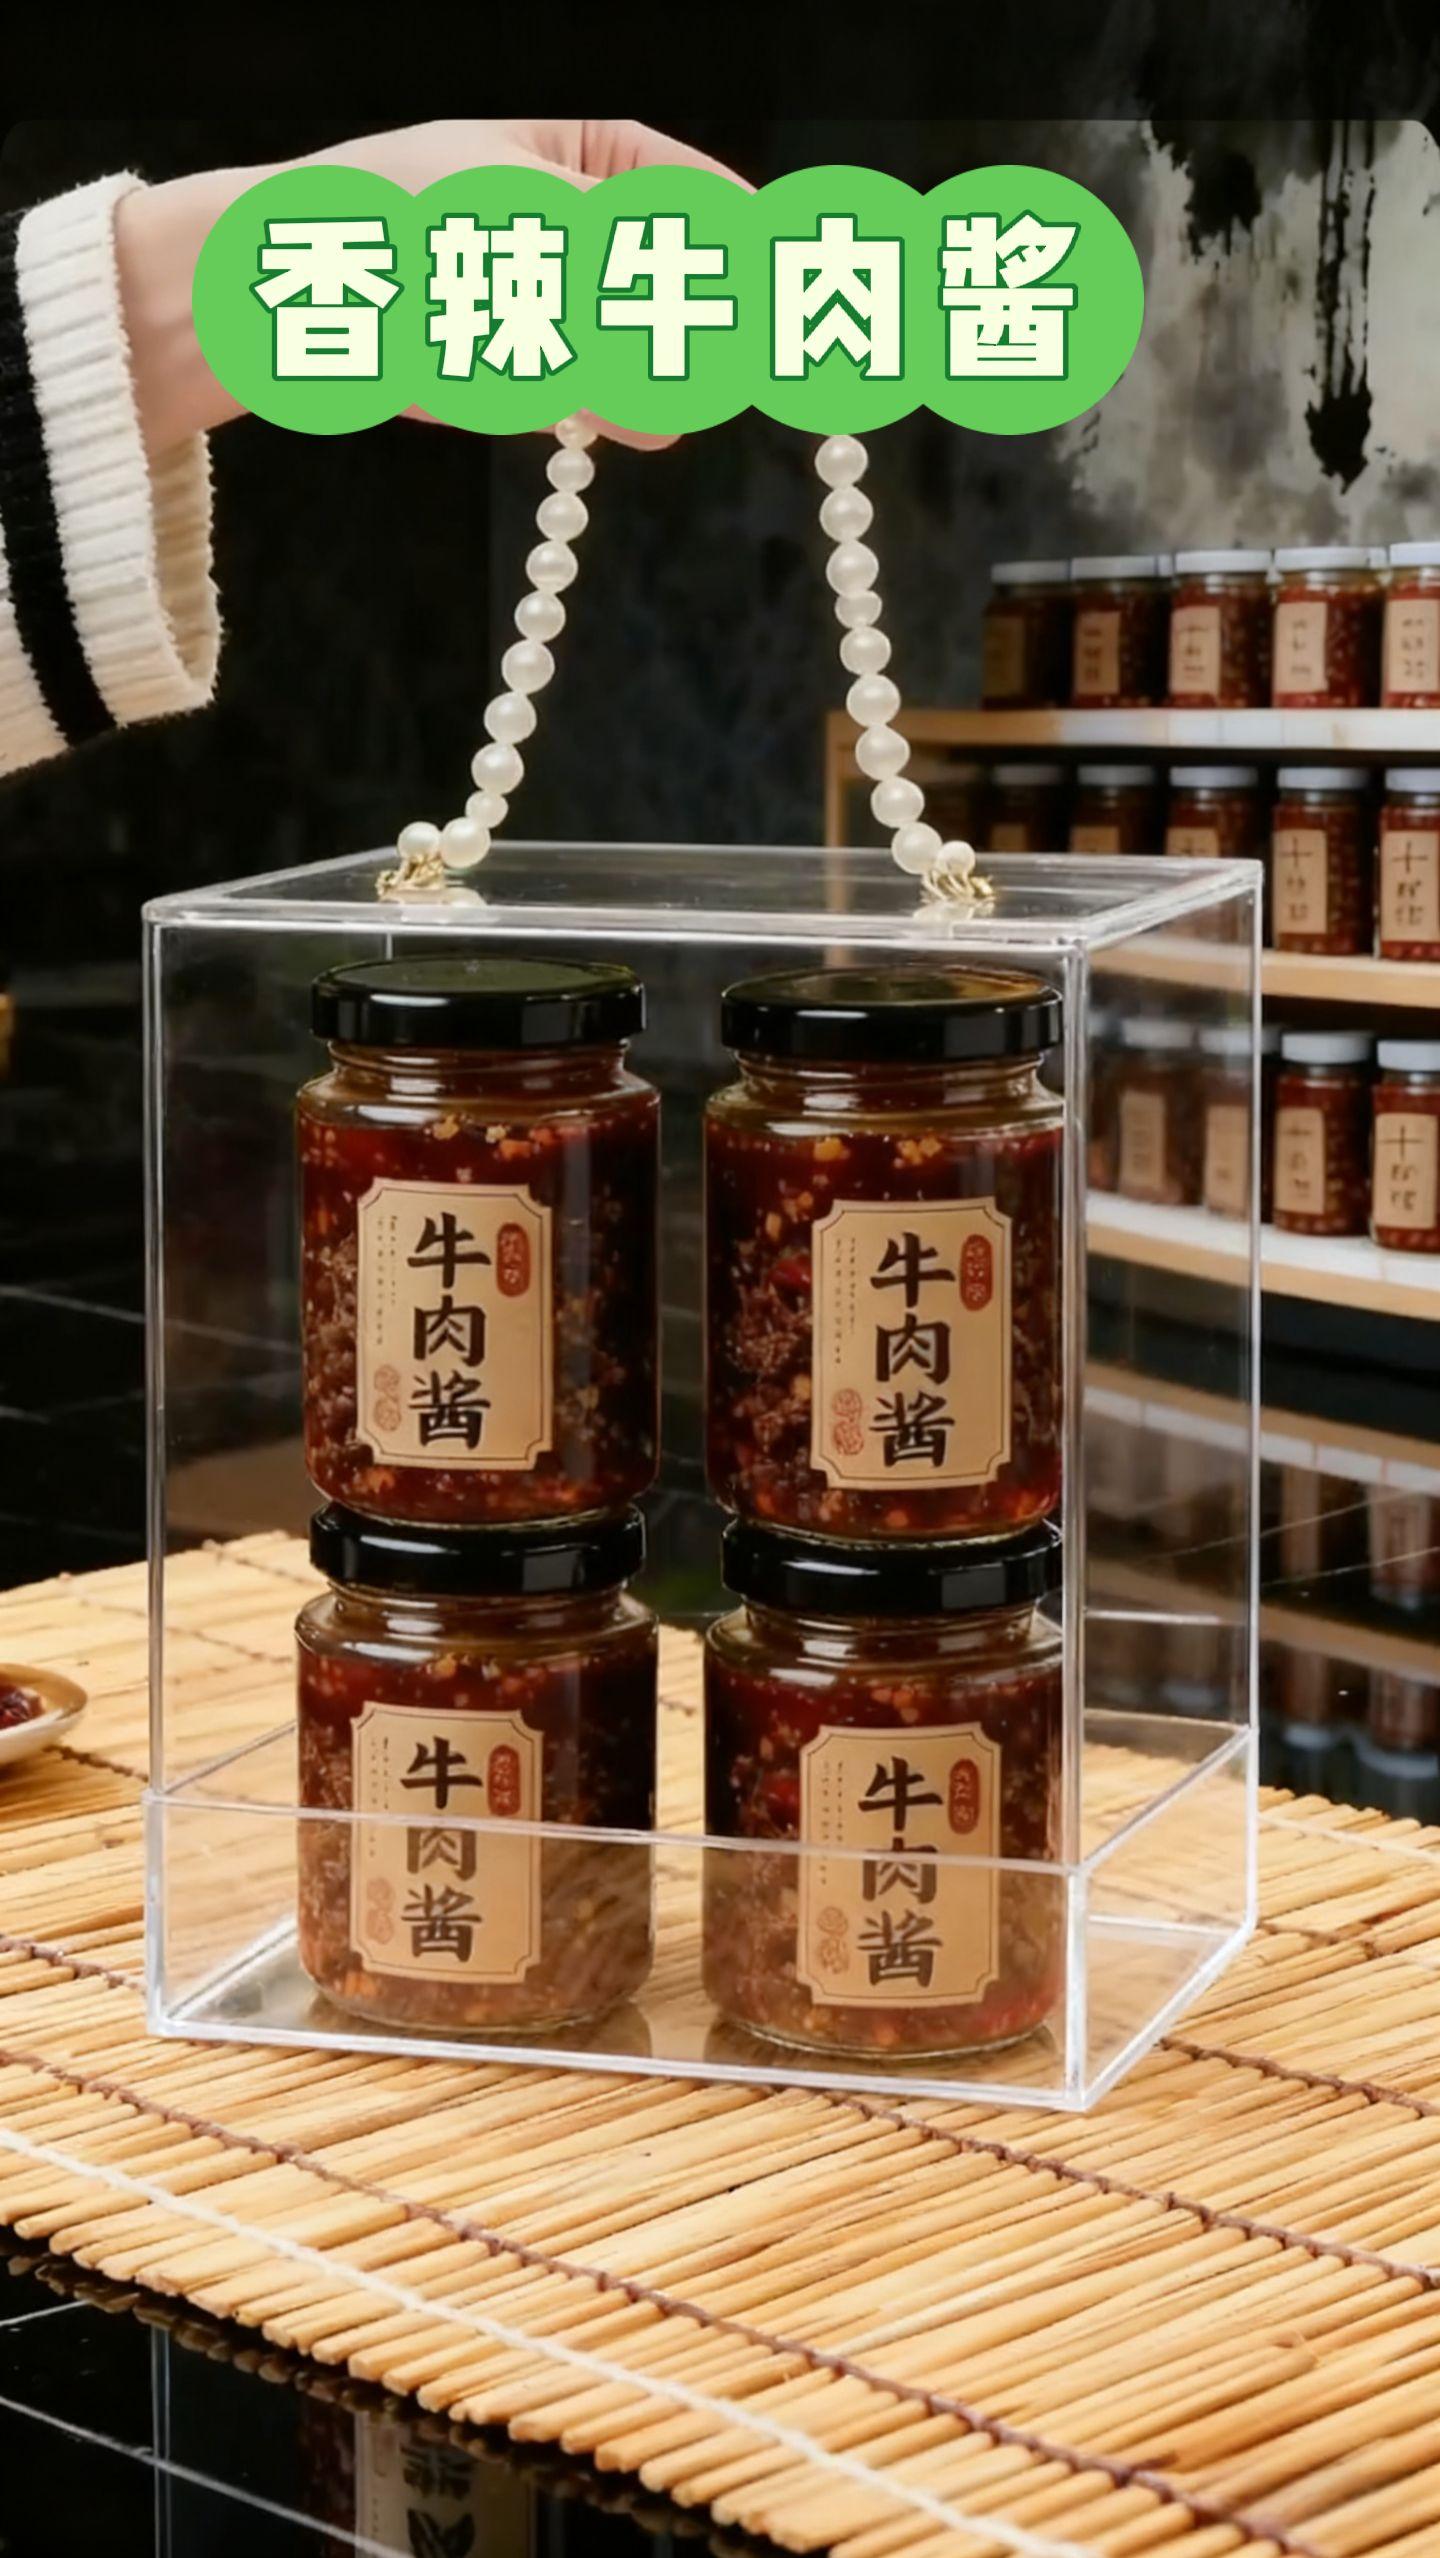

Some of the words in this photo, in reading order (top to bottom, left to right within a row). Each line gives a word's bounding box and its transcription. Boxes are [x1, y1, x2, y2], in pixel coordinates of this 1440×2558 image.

[407, 1212, 491, 1449] 牛肉酱
[870, 1232, 955, 1468] 牛肉酱
[400, 1735, 483, 1963] 牛肉酱
[857, 1755, 943, 1988] 牛肉酱
